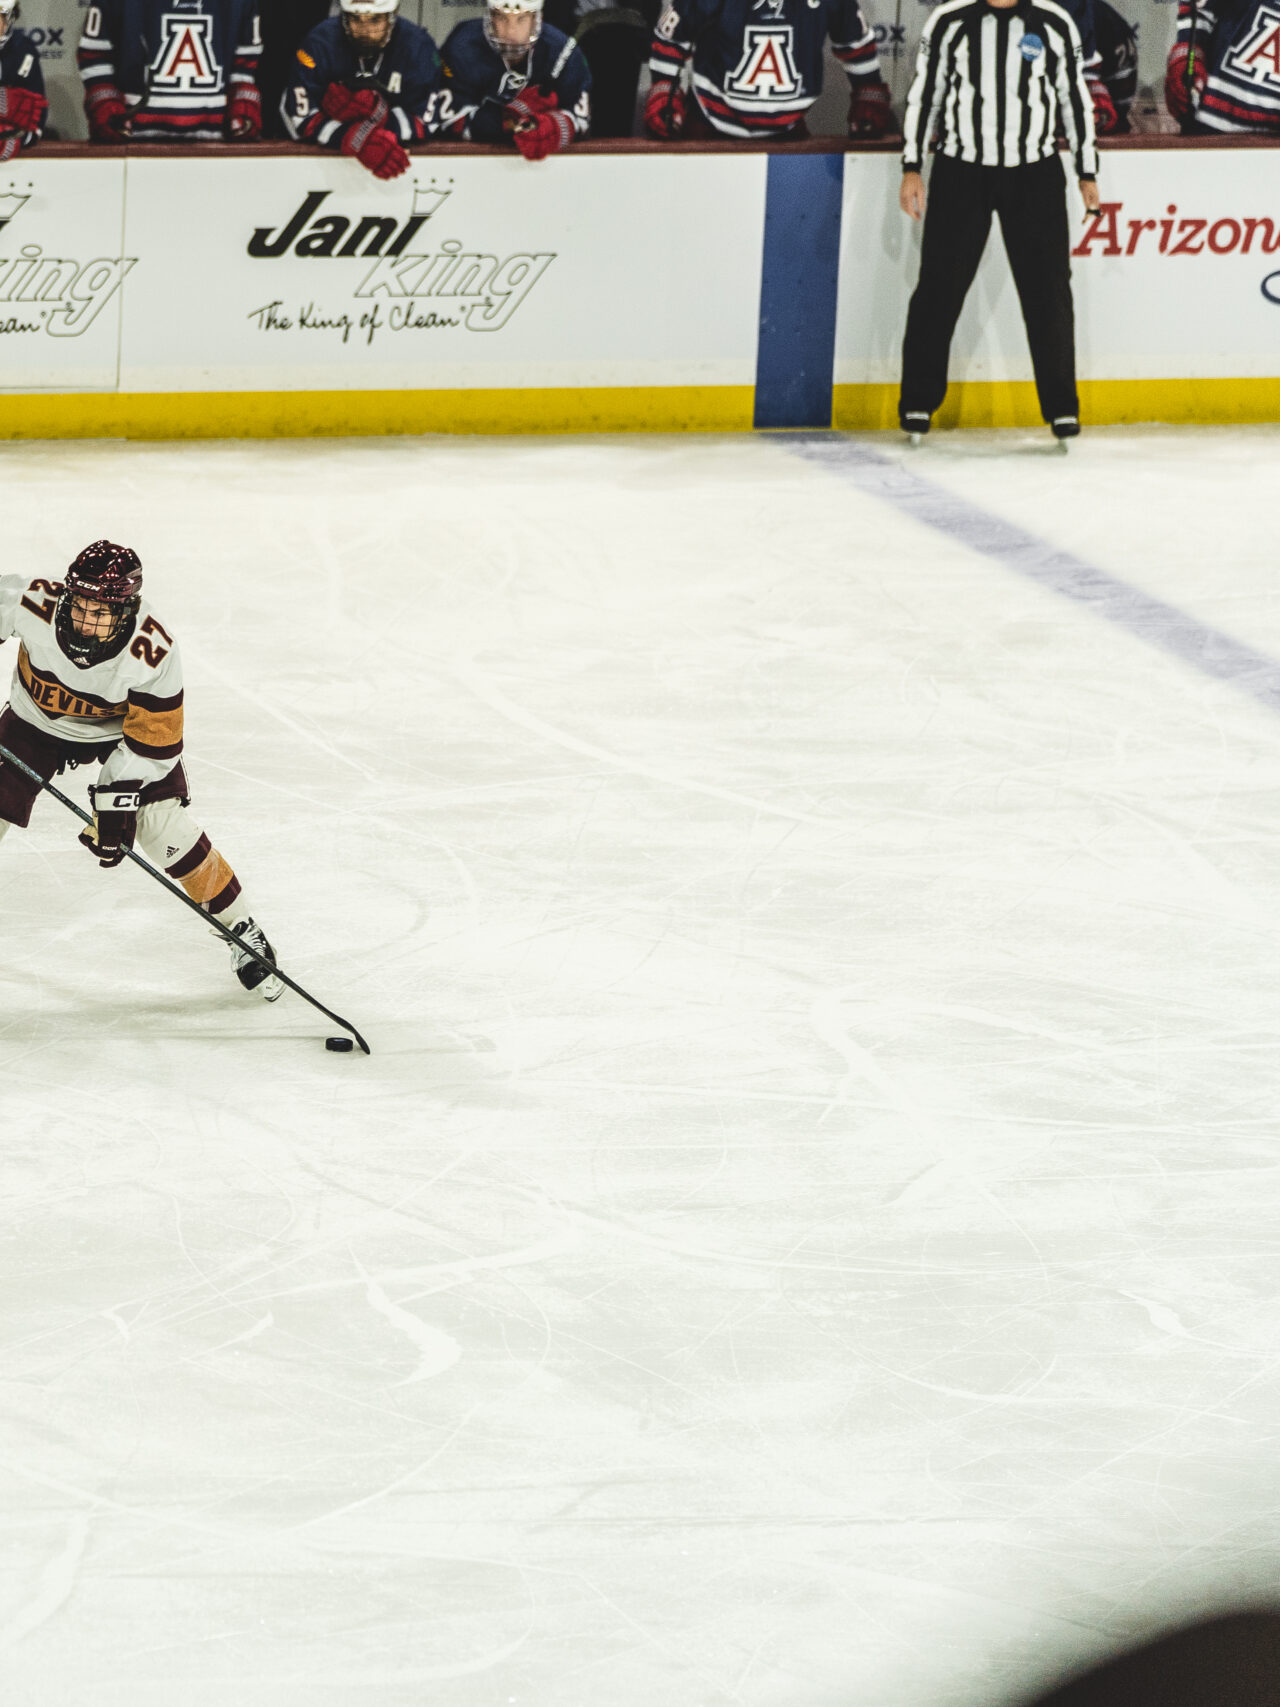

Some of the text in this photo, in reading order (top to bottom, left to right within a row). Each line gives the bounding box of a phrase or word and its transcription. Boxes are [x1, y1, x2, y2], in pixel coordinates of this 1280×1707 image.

[26, 27, 64, 46] OX
[148, 18, 221, 92] A
[387, 71, 402, 94] A
[728, 30, 799, 98] A
[293, 86, 309, 117] 5
[247, 190, 432, 258] Jani
[1071, 202, 1280, 257] Arizon
[248, 301, 293, 331] The
[299, 303, 352, 343] King
[359, 303, 383, 345] of
[21, 578, 65, 626] 27
[76, 580, 101, 592] CCM
[130, 614, 173, 669] 27
